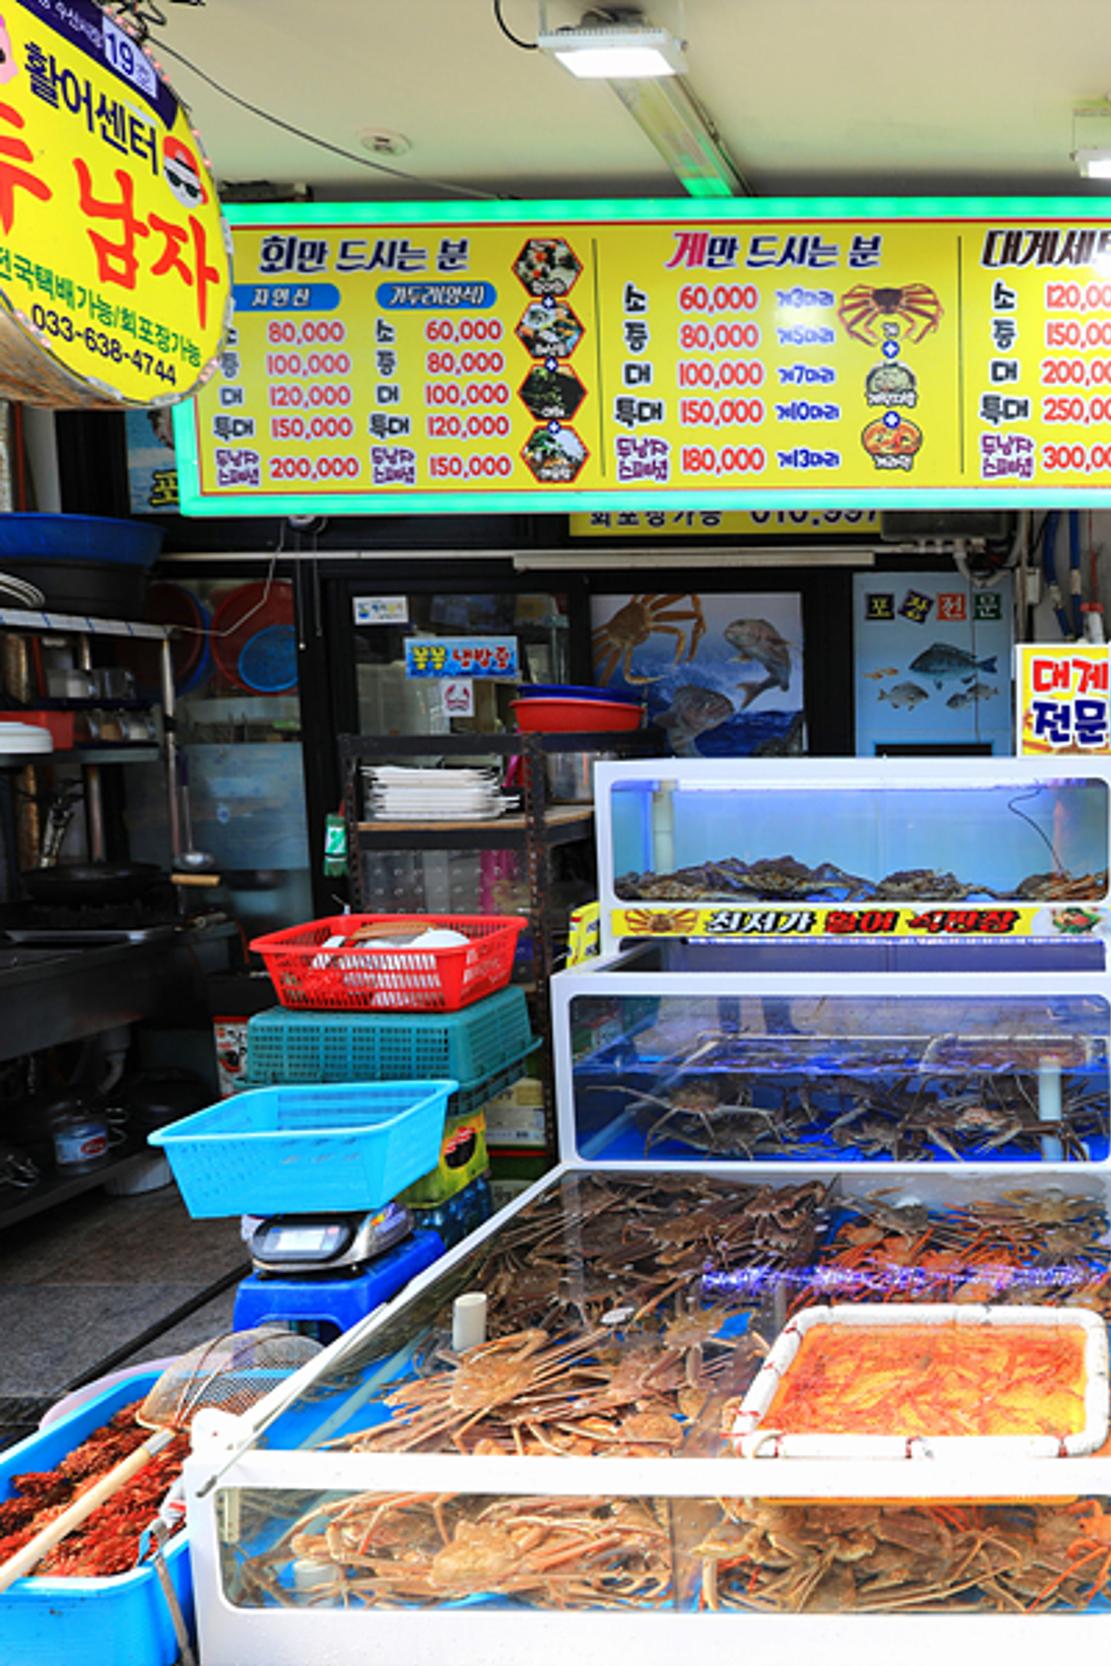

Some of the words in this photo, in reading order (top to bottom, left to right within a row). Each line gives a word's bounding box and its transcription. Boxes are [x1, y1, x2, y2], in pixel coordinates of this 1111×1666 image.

[25, 42, 158, 175] 활어센터
[73, 157, 220, 330] 남자
[260, 236, 328, 272] 회만
[336, 240, 426, 271] 드시는
[437, 239, 468, 271] 분
[665, 232, 739, 268] 게만
[746, 235, 838, 268] 드시는
[849, 234, 881, 268] 분
[252, 288, 310, 307] 자연산
[625, 283, 647, 312] 소
[679, 285, 758, 313] 60,000
[993, 282, 1015, 309] 소
[32, 303, 178, 386] 033-638-4744
[268, 321, 345, 345] 80,000
[376, 319, 395, 343] 소
[425, 320, 502, 344] 60,000
[624, 322, 647, 353] 중
[680, 324, 760, 351] 80,000
[993, 319, 1015, 349] 중
[222, 351, 239, 377] 중
[266, 353, 350, 378] 100,000
[377, 350, 396, 376] 중
[427, 351, 504, 375] 80,000
[624, 364, 651, 384] 대
[678, 362, 764, 389] 100,000
[991, 361, 1017, 381] 대
[220, 387, 243, 405] 대
[269, 384, 351, 409] 120,000
[377, 385, 399, 404] 대
[425, 383, 509, 407] 100,000
[615, 397, 663, 427] 특대
[680, 399, 764, 426] 150,000
[980, 394, 1029, 424] 특대
[214, 416, 254, 441] 특대
[271, 416, 353, 440] 150,000
[370, 414, 410, 440] 특대
[427, 415, 510, 438] 120,000
[270, 457, 359, 480] 200,000
[429, 455, 512, 479] 150,000
[681, 447, 766, 474] 180,000
[453, 645, 510, 669] 냉방중
[1033, 659, 1108, 693] 대게
[1033, 700, 1108, 743] 전문
[706, 910, 816, 933] 최저가
